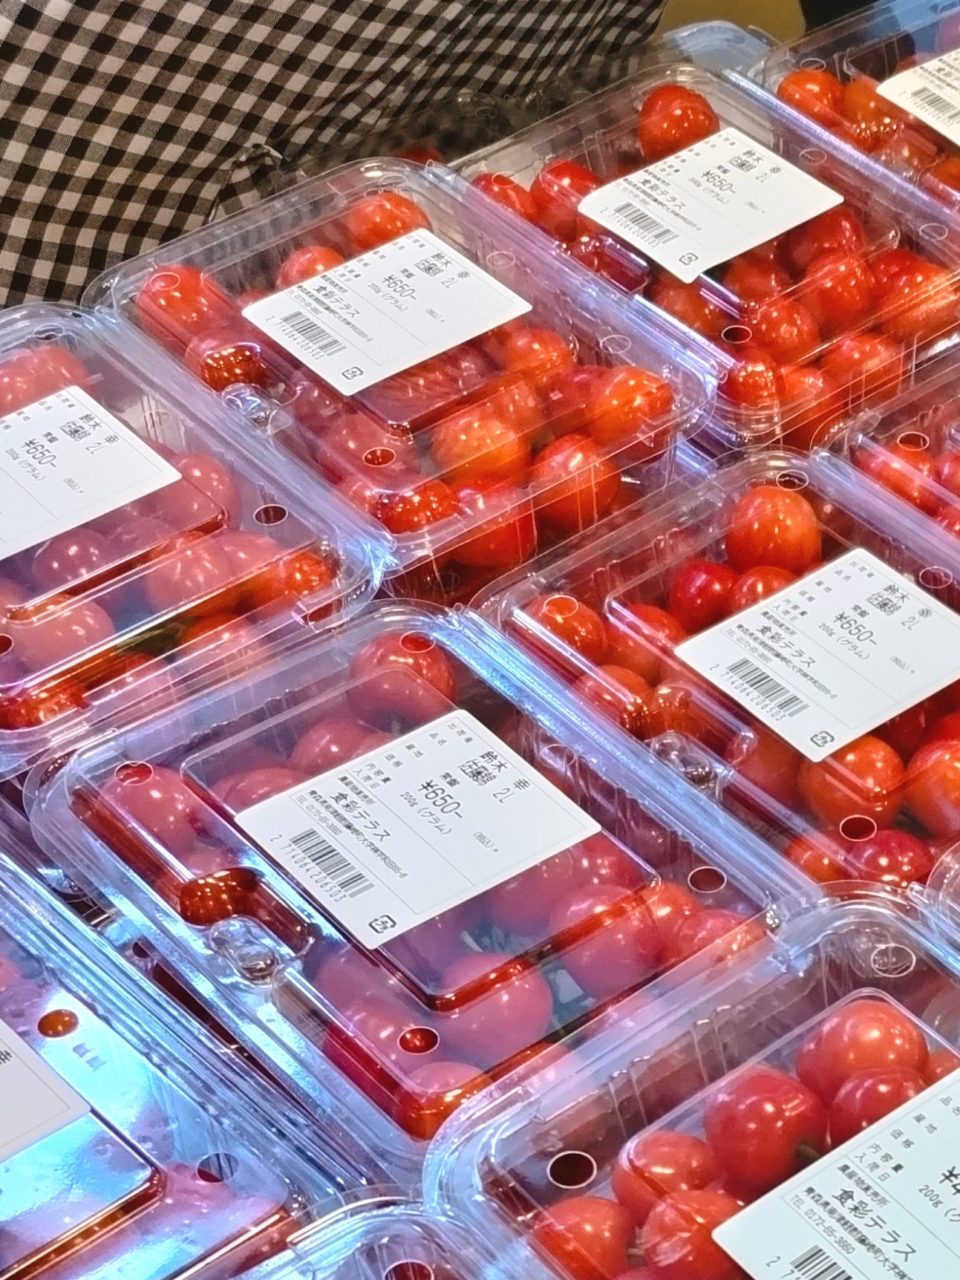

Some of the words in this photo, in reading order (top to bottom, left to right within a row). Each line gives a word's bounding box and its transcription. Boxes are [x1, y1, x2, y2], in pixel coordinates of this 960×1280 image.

[700, 169, 736, 193] ¥650-
[380, 273, 417, 300] ¥650-
[20, 437, 57, 468] ¥650-
[832, 611, 877, 645] ¥650-
[900, 616, 921, 631] 2L
[416, 779, 463, 818] ¥650-
[491, 787, 515, 804] 2L
[329, 791, 391, 842] 食彩テラス
[270, 833, 283, 841] 2
[889, 1128, 915, 1149] 価格
[853, 1152, 891, 1183] 入荷日
[868, 1143, 904, 1174] 内容量
[789, 1193, 805, 1210] TEL
[831, 1188, 917, 1263] 食彩テラス
[766, 1254, 782, 1266] 2
